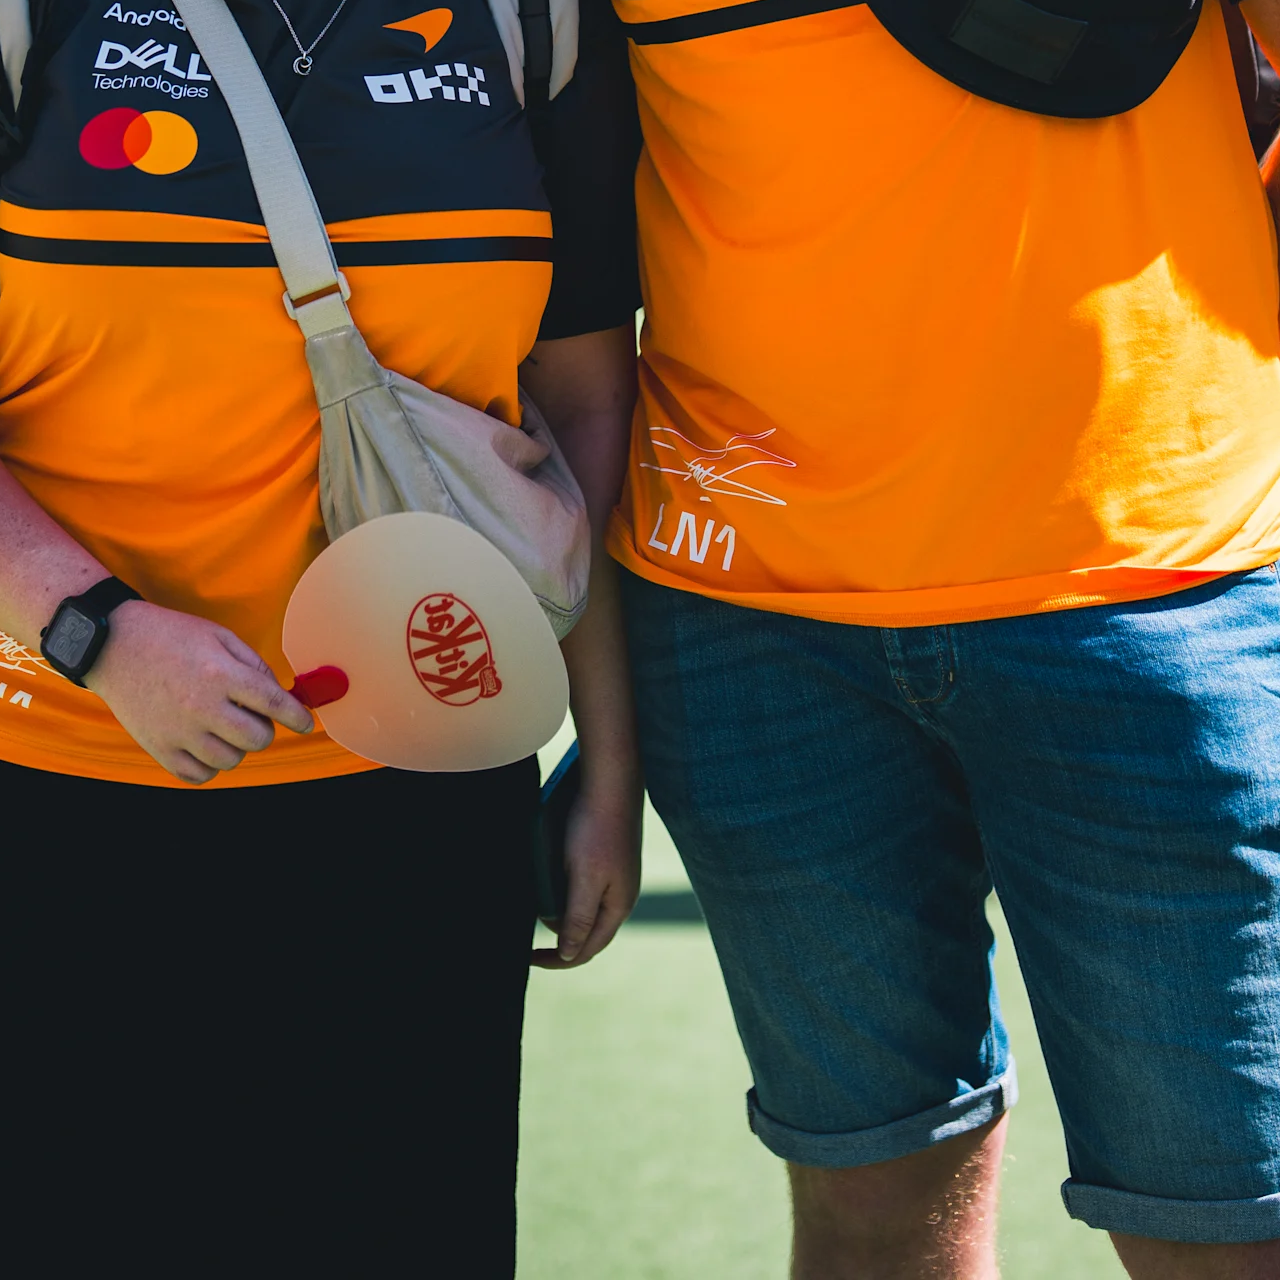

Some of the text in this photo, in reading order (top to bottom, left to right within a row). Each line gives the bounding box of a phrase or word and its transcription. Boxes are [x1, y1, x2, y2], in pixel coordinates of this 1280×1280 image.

[102, 2, 187, 32] Andoid
[94, 38, 213, 82] DELL
[91, 73, 210, 100] Technologies
[363, 62, 491, 107] OKX
[647, 503, 737, 572] LN1
